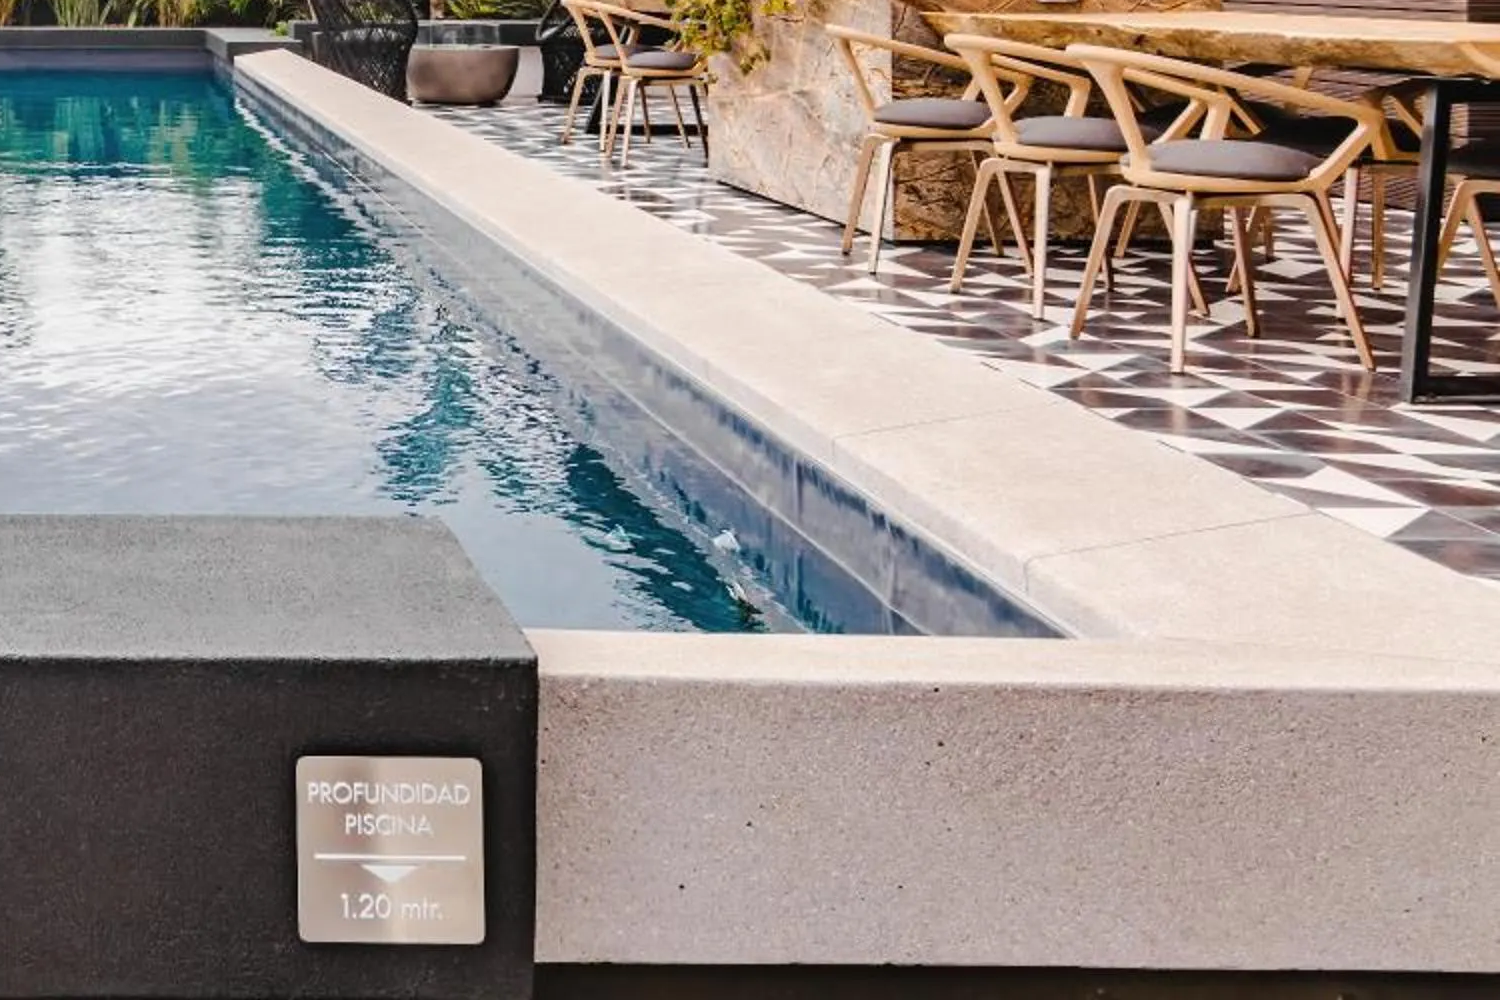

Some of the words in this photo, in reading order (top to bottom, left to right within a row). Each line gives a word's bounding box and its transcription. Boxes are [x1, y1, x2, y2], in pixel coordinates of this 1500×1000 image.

[307, 781, 471, 805] PROFUNDIDAD
[345, 813, 434, 836] PISCINA
[340, 893, 392, 919] 1.20
[401, 897, 443, 920] mtr.
